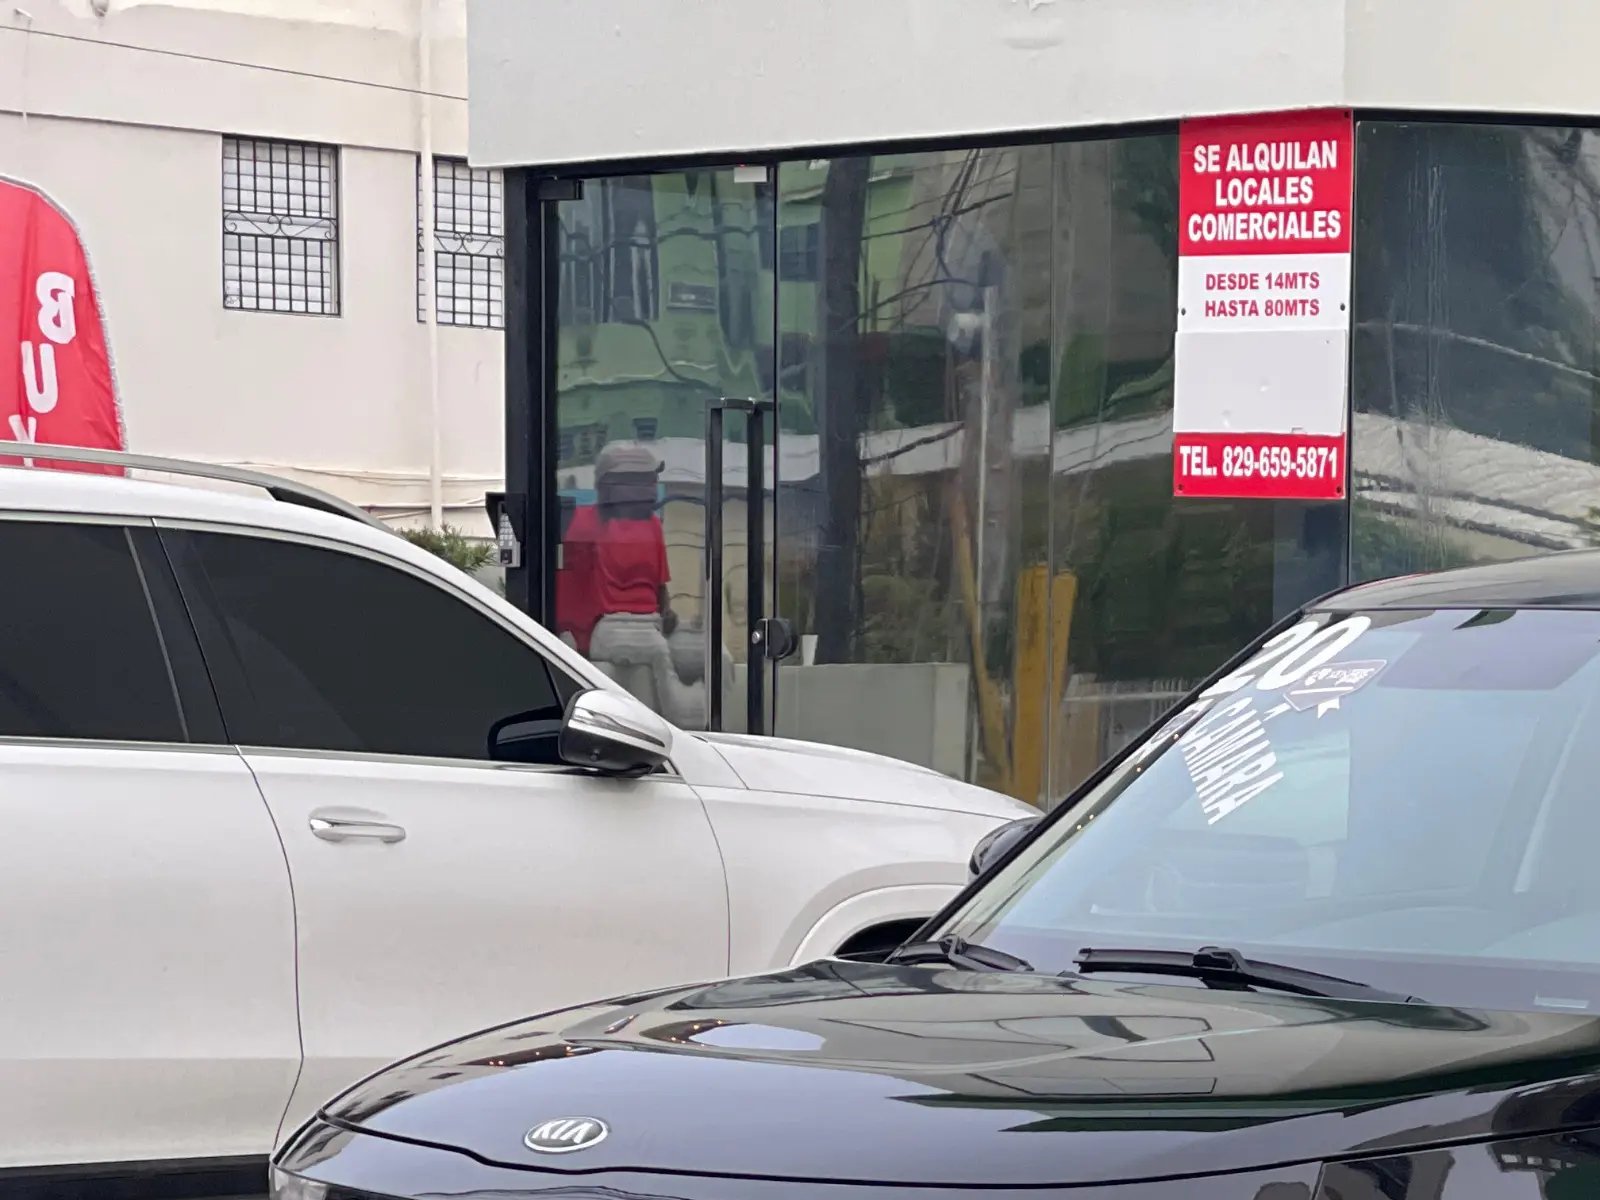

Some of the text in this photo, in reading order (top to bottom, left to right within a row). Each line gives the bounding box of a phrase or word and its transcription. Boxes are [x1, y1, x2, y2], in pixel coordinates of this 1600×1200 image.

[1194, 140, 1337, 172] SE ALQUILAN
[1215, 176, 1313, 207] LOCALES
[1188, 210, 1341, 241] COMERCIALES
[1205, 272, 1320, 290] DESDE 14MTS
[1205, 299, 1320, 317] HASTA 80MTS
[1179, 445, 1337, 478] TEL. 829-659-5871
[531, 1119, 594, 1144] KIA
